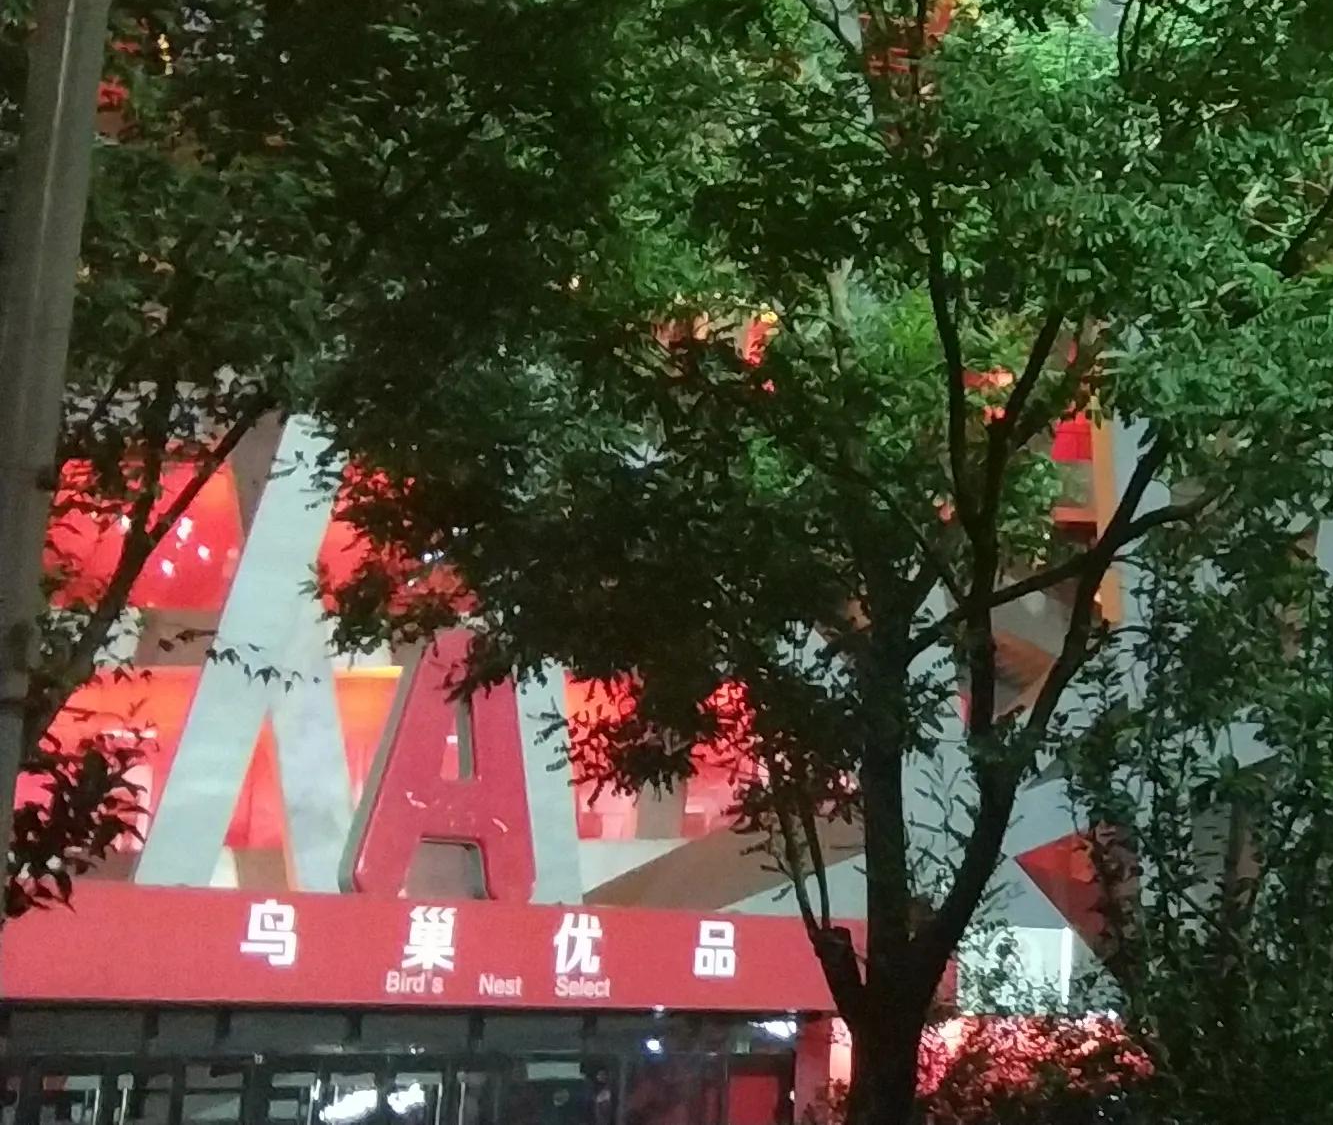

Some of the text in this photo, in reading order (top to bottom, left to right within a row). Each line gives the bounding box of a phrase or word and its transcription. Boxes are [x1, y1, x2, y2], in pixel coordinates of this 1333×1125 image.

[239, 898, 737, 978] 鸟巢优品
[385, 969, 611, 999] Bird's Nest Select
